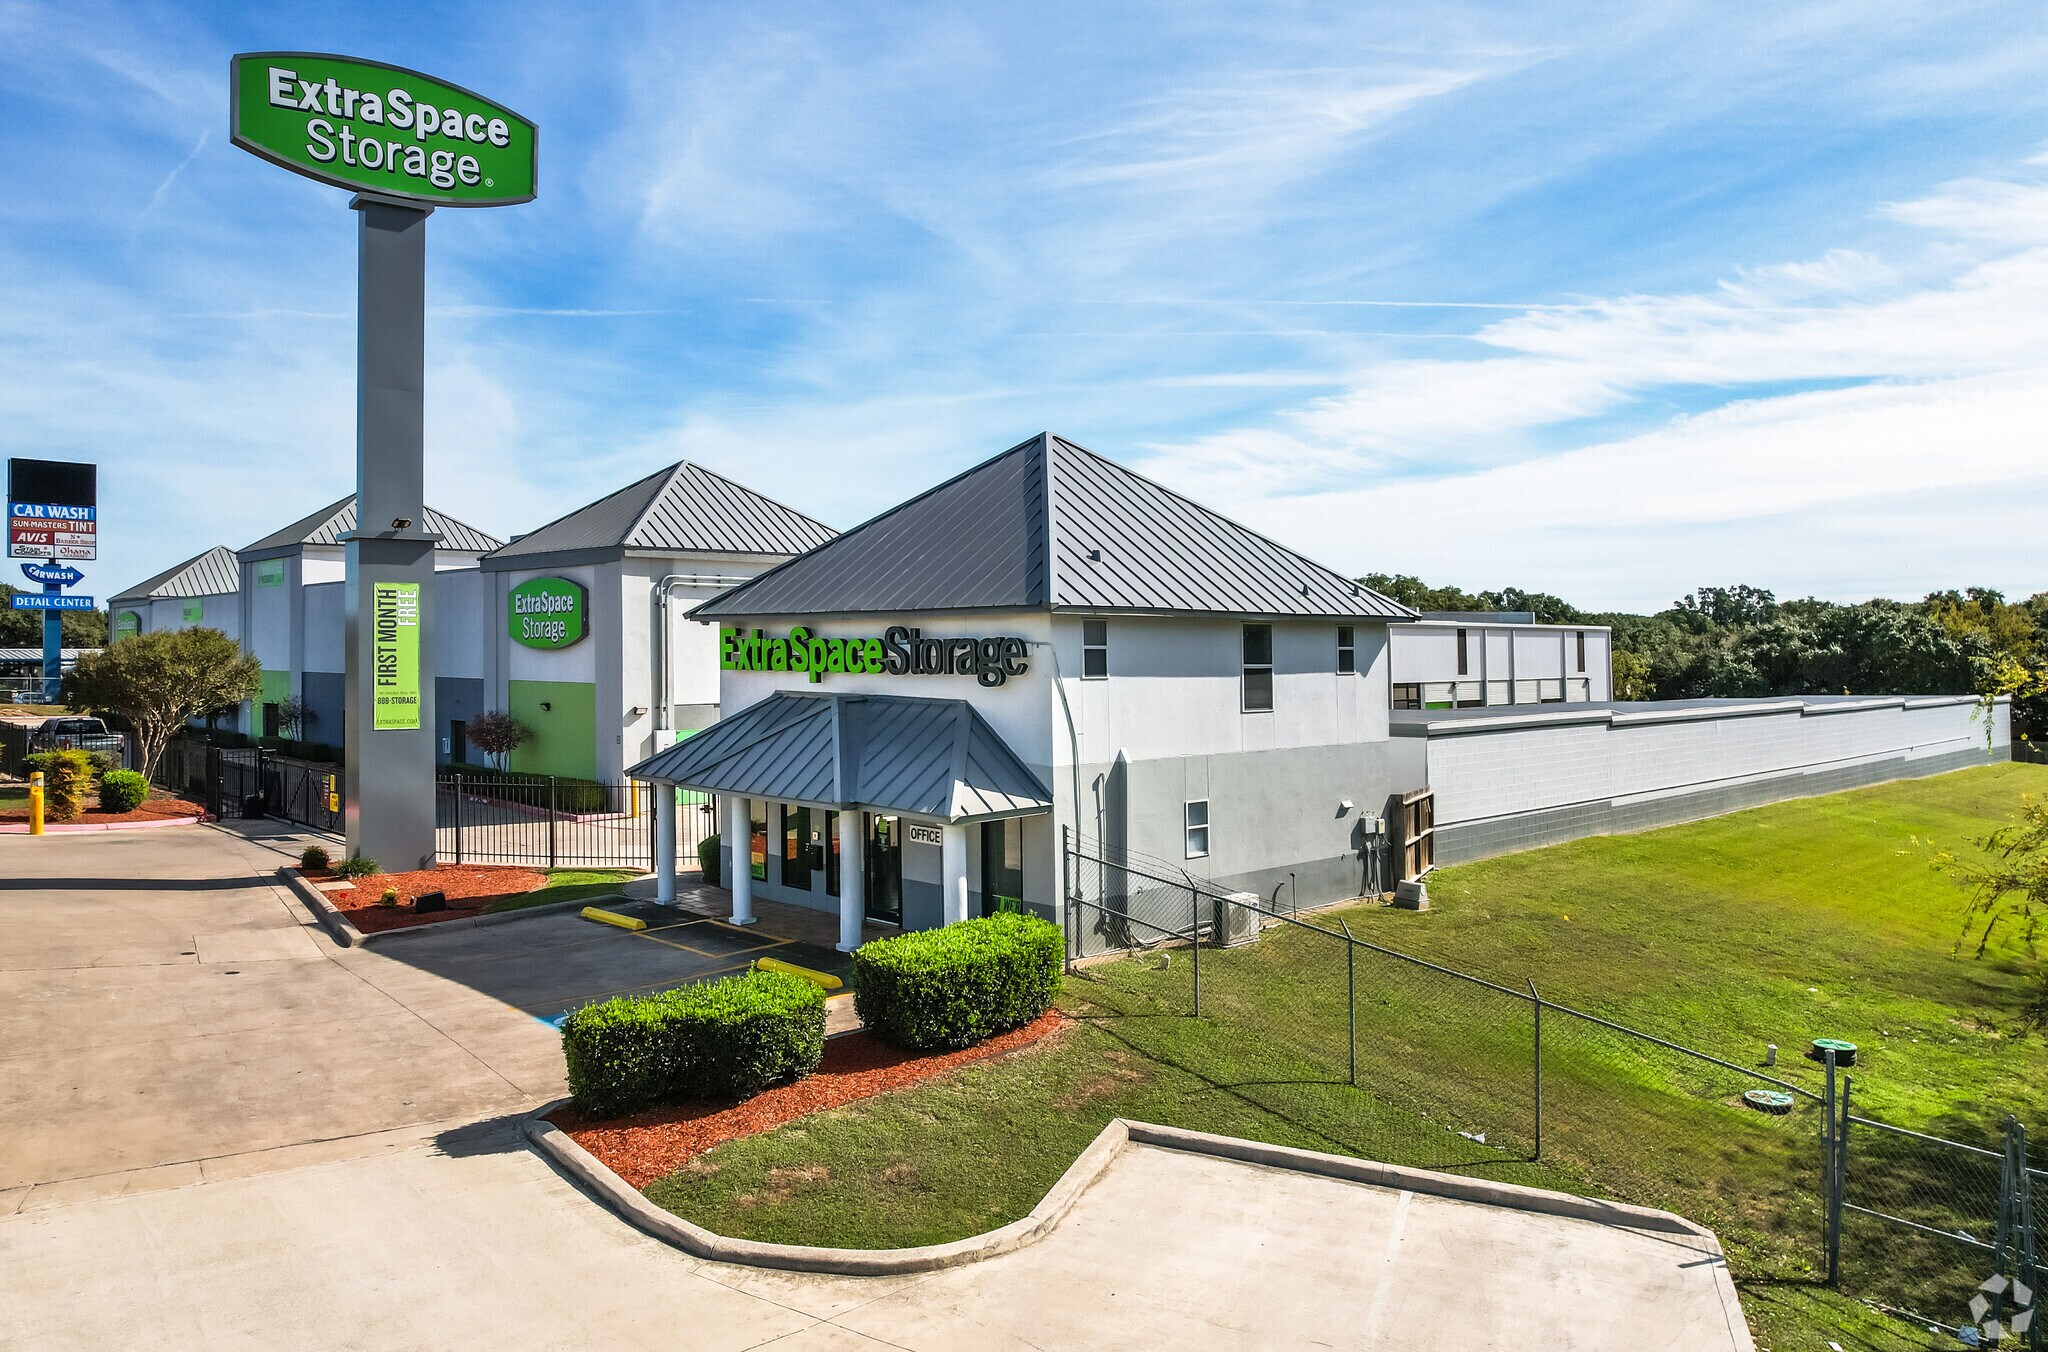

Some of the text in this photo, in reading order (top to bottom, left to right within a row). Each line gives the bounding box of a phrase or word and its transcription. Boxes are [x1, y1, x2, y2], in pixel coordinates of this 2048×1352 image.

[268, 66, 511, 147] ExtraSpace
[305, 118, 481, 189] Storage
[13, 504, 88, 520] CAR WASH
[68, 521, 94, 533] TINT
[17, 532, 48, 543] AVIS
[28, 566, 74, 580] CARWASH
[16, 597, 91, 607] DETAIL CENTER
[398, 589, 417, 626] FREE
[515, 591, 574, 617] ExtraSpace
[377, 589, 397, 686] FIRST MONTH
[522, 616, 566, 643] Storage
[377, 696, 417, 705] 888-STORAGE
[910, 827, 941, 843] OFFICE
